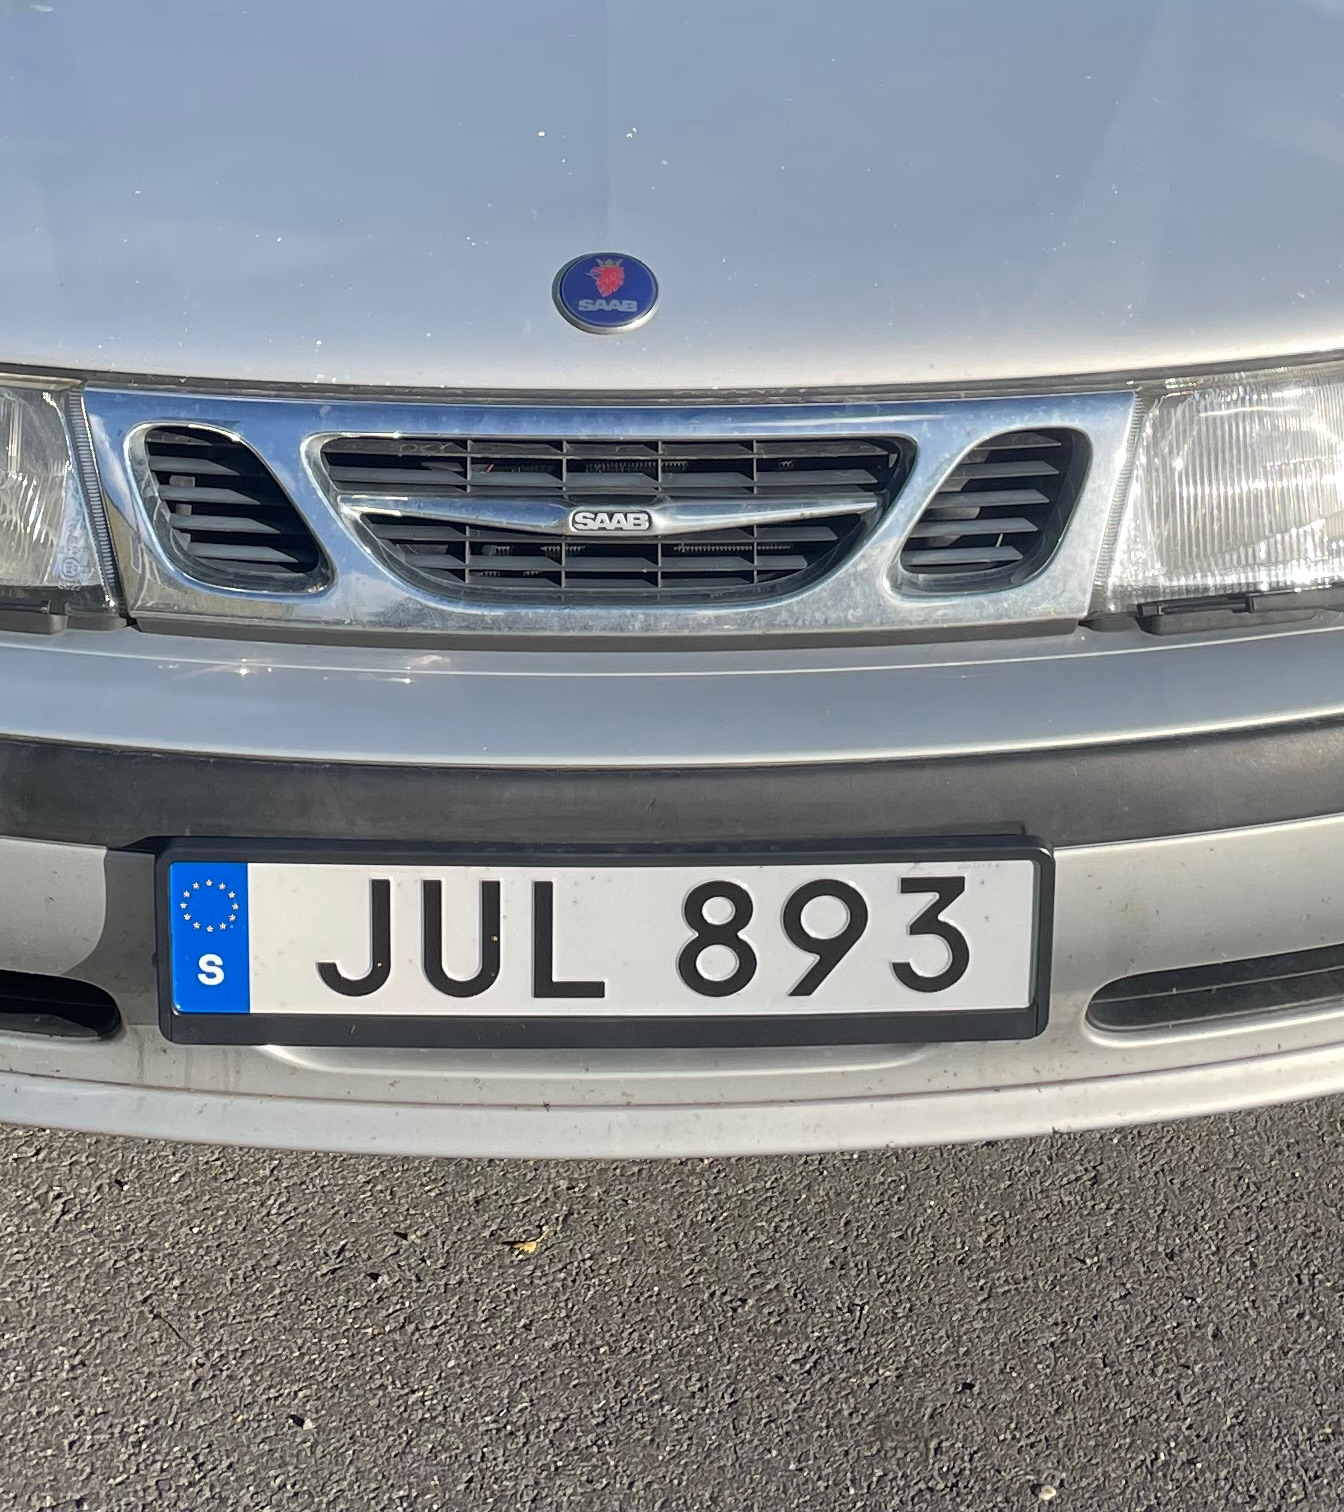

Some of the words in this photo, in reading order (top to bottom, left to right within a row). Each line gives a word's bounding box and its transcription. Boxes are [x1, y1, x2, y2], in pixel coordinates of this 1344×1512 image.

[578, 299, 638, 312] SAAB
[574, 512, 649, 530] SAAB
[317, 879, 606, 999] JUL
[678, 875, 970, 998] 893
[197, 953, 225, 986] S
